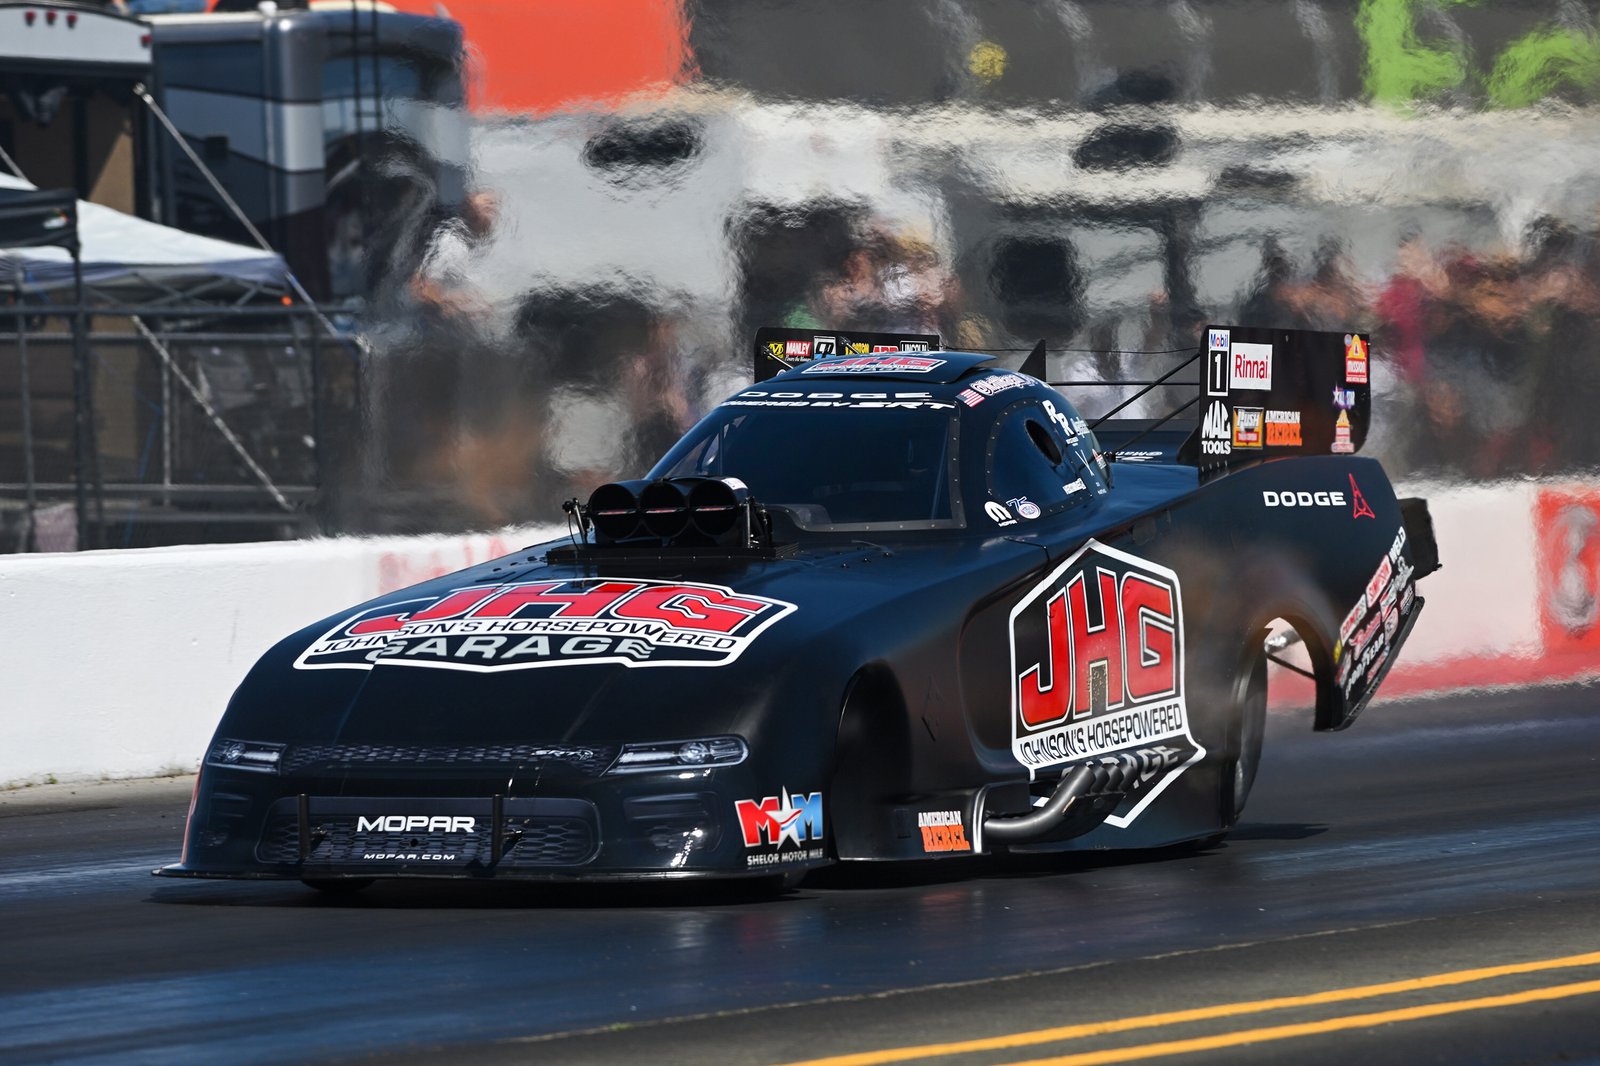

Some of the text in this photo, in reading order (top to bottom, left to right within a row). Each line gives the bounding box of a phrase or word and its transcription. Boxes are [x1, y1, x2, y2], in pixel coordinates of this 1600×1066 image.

[786, 341, 810, 355] MANLEY
[1210, 334, 1228, 347] Mobil
[1214, 353, 1222, 389] 1
[1235, 354, 1269, 379] Rinnai
[738, 391, 933, 399] DODGE
[849, 402, 955, 410] SRT
[1202, 400, 1231, 439] MAC
[1265, 410, 1300, 424] AMERICAN
[1202, 440, 1231, 455] TOOLS
[1263, 491, 1347, 507] DODGE
[1389, 526, 1406, 564] WELD
[347, 581, 766, 637] JHG
[314, 619, 738, 653] JOHNSON'S HORSEPOWERED
[365, 636, 657, 662] GARAGE
[1018, 565, 1176, 731] JHG
[1020, 703, 1183, 765] JOHNSON'S HORSEPOWERED
[356, 815, 476, 833] MOPAR
[918, 811, 961, 827] AMERICAN
[921, 825, 971, 852] REBEL
[747, 848, 823, 866] SHELOR MOTOR MILE
